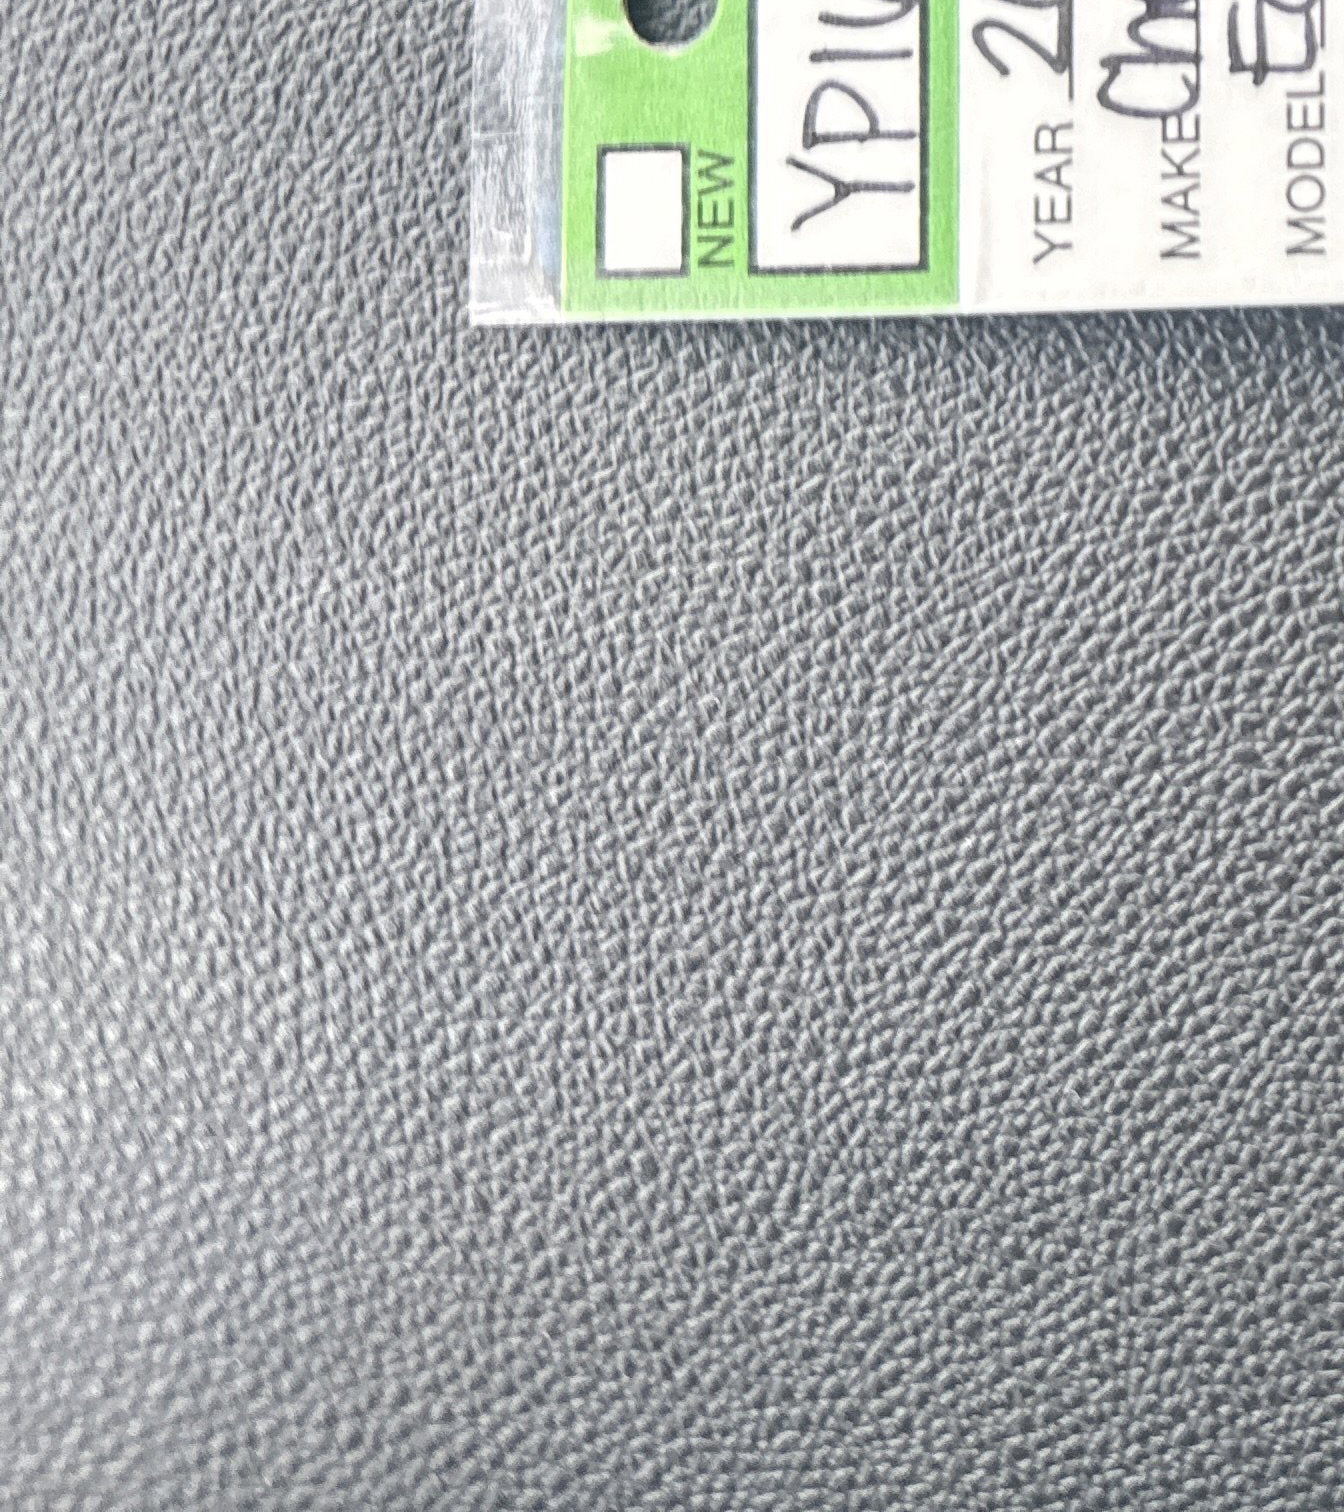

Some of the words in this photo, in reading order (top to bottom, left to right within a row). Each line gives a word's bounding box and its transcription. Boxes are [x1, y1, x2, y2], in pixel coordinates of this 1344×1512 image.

[698, 150, 735, 269] NEW
[1033, 120, 1074, 265] YEAR
[1161, 115, 1201, 261] MAKE
[1285, 69, 1327, 257] MODEL
